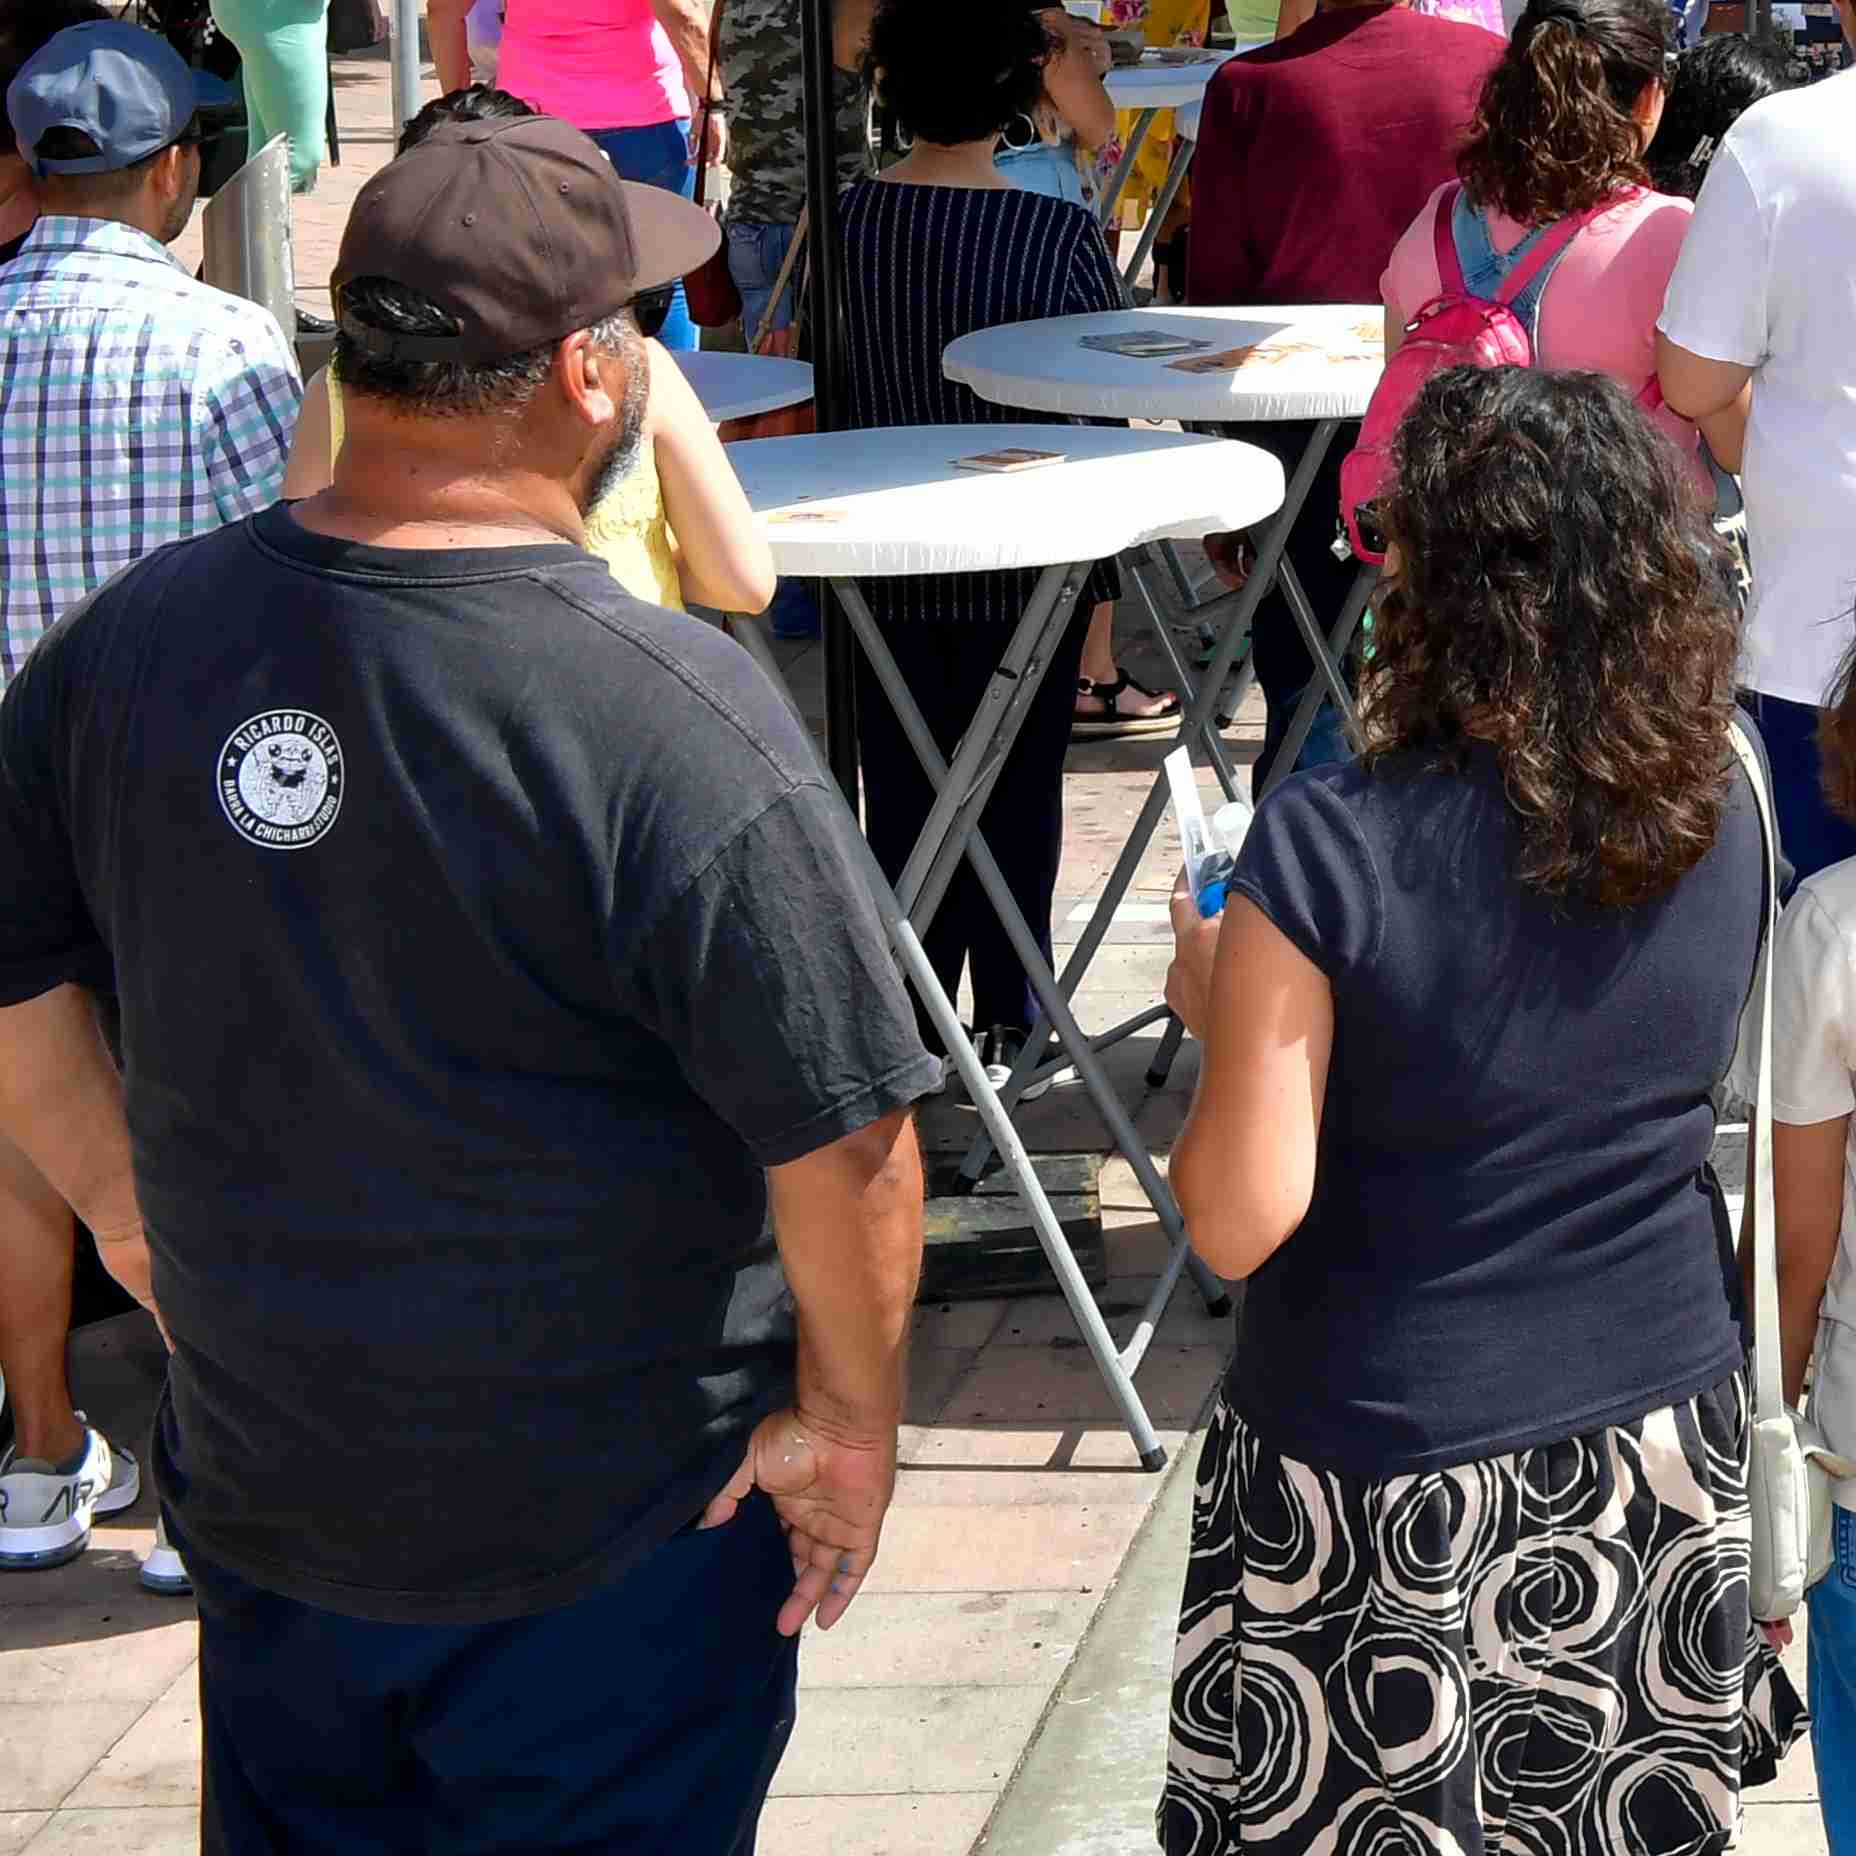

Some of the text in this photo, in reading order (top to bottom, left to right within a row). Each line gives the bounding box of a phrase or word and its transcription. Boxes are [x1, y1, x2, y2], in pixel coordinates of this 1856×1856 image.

[234, 715, 306, 752] RICARDO
[308, 722, 339, 766] ISLAS
[239, 813, 256, 831] LA
